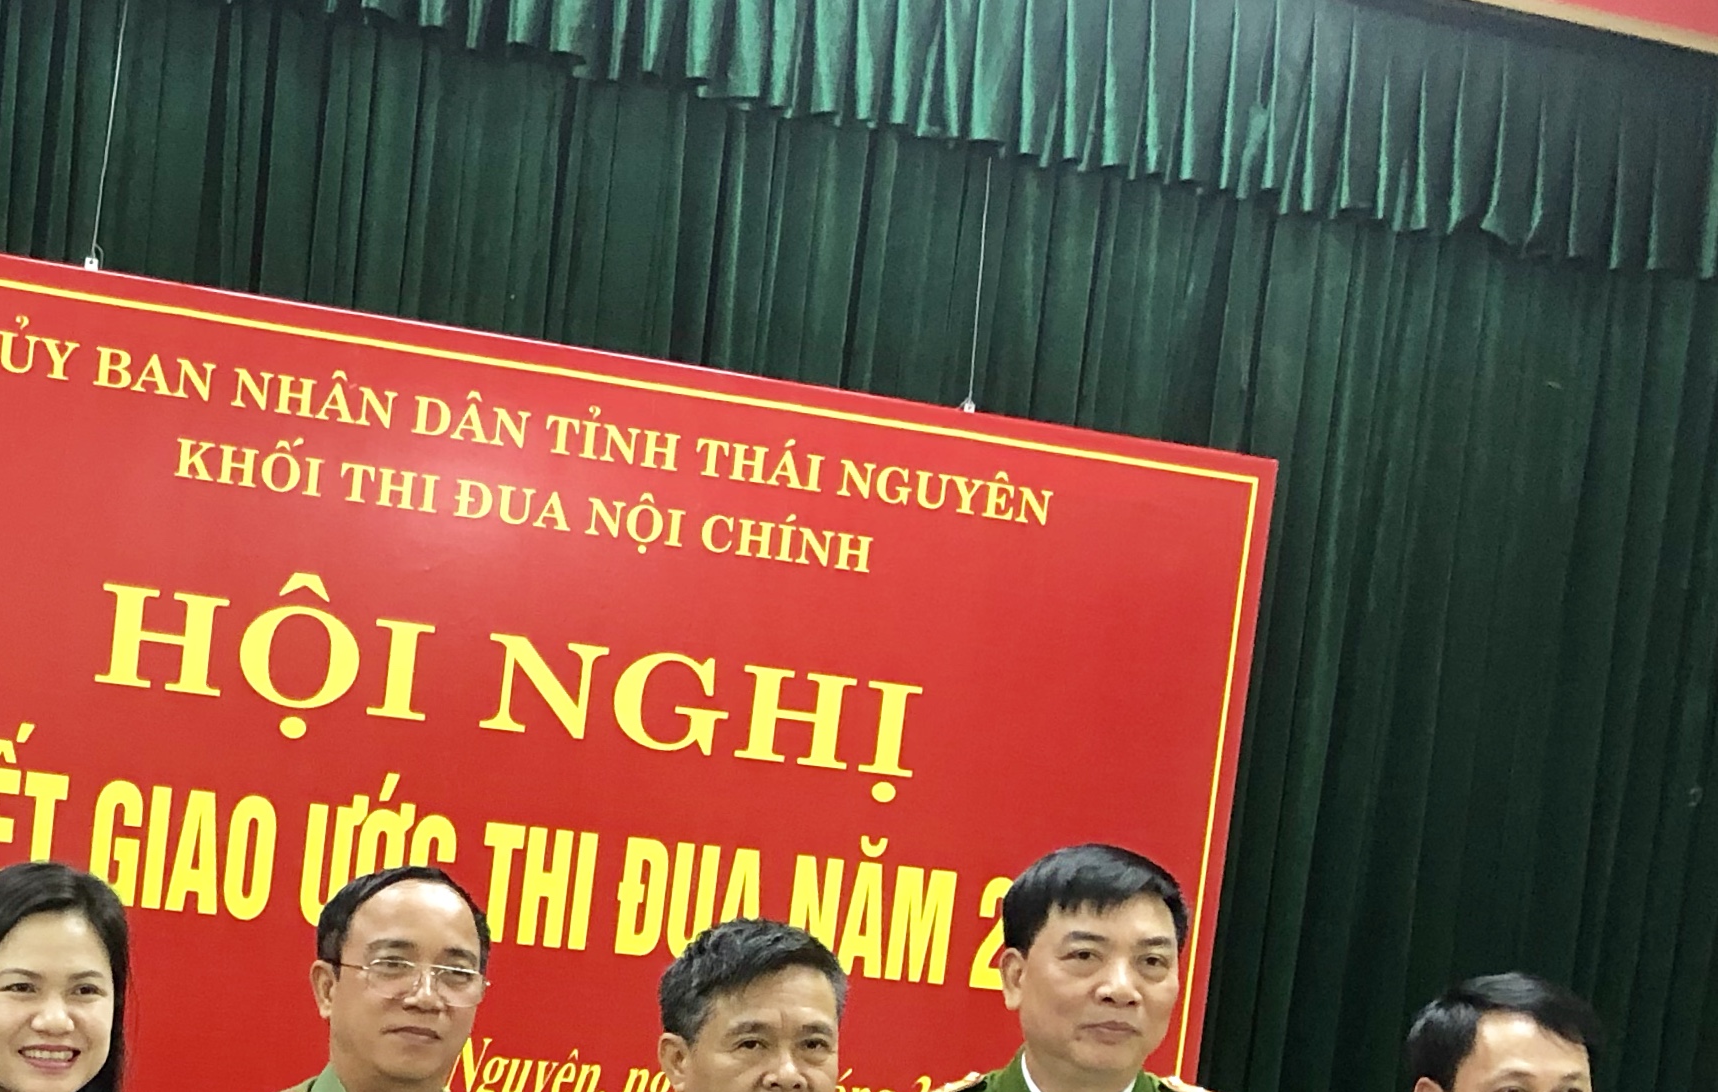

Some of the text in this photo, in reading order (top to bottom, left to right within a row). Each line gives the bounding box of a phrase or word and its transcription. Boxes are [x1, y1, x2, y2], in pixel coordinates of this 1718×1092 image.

[92, 345, 217, 402] BAN
[230, 367, 398, 429] NHÂN
[411, 390, 532, 449] DÂN
[546, 404, 682, 472] TỈNH
[696, 437, 824, 493] THÁI
[837, 459, 1054, 527] NGUYÊN
[174, 437, 875, 573] KHỐI THI ĐUA NỘI CHÍNH
[94, 571, 924, 804] HỘI NGHỊ
[89, 779, 277, 921] GIAO
[483, 821, 599, 951] THI
[614, 836, 761, 960] ĐUA
[788, 834, 958, 985] NĂM
